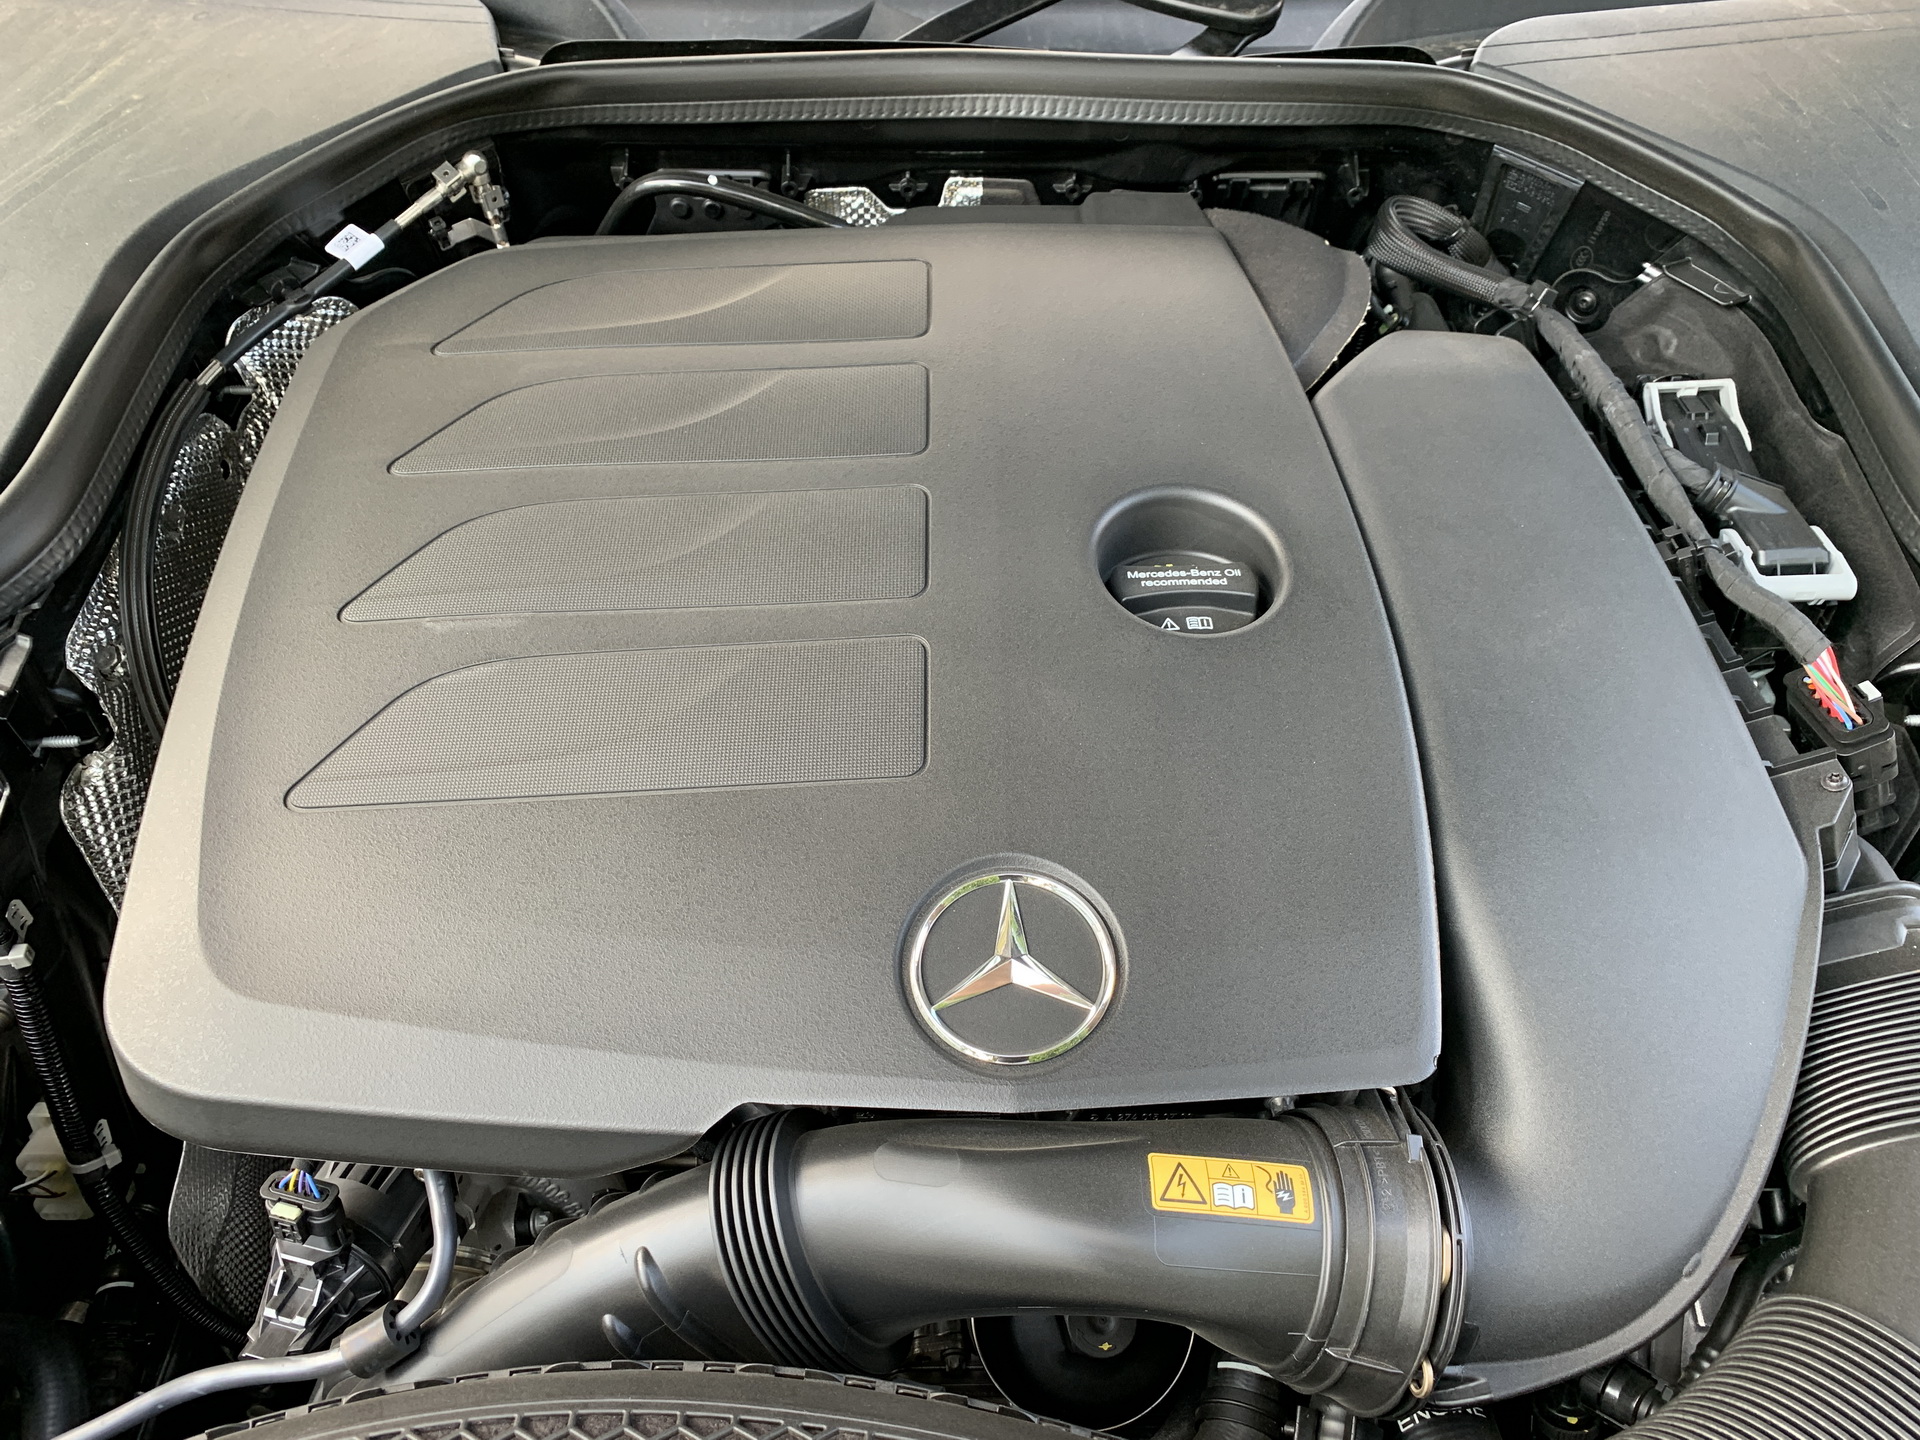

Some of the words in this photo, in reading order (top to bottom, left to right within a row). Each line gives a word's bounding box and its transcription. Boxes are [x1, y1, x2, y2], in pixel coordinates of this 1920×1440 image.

[1126, 569, 1222, 579] Mercedes-Benz
[1225, 569, 1241, 577] Oil
[1140, 577, 1228, 587] recommended
